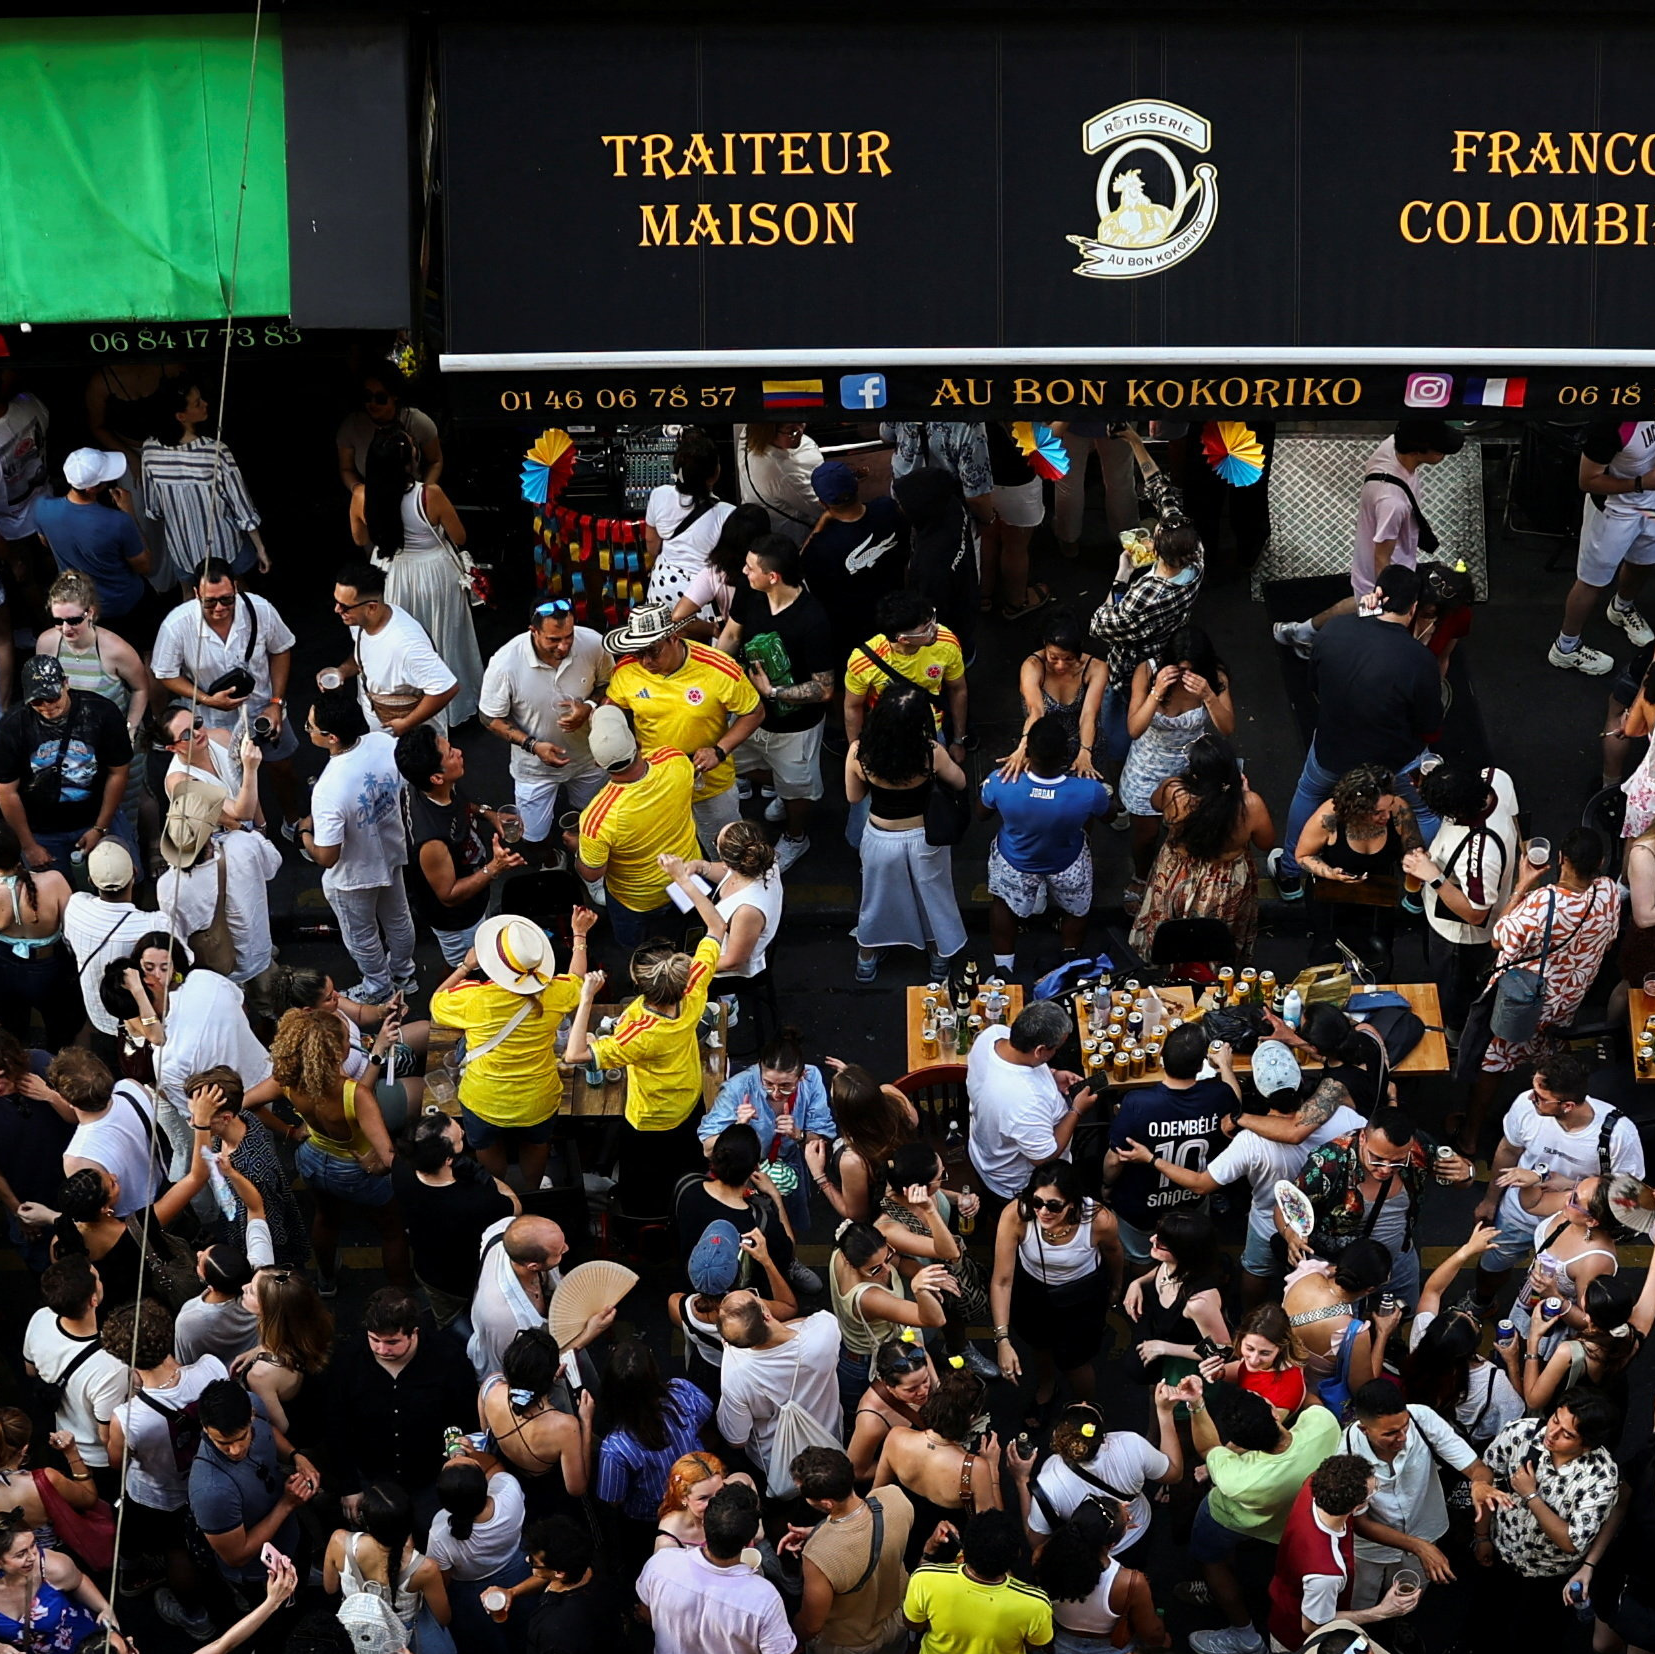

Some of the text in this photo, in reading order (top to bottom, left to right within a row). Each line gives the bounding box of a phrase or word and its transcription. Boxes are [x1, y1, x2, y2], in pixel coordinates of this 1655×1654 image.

[1104, 112, 1194, 137] RÔTISSERIE
[601, 130, 893, 181] TRAITEUR
[638, 201, 859, 248] MAISON
[1107, 220, 1205, 267] AU BON KOKORIKO
[90, 323, 303, 353] 06 84 17 73 83
[500, 385, 737, 412] 01 46 06 78 57
[930, 376, 1363, 409] AU BON KOKORIKO
[1557, 385, 1599, 406] 06
[1609, 382, 1642, 406] 18
[1149, 1113, 1219, 1137] O.DEMBÉLÉ
